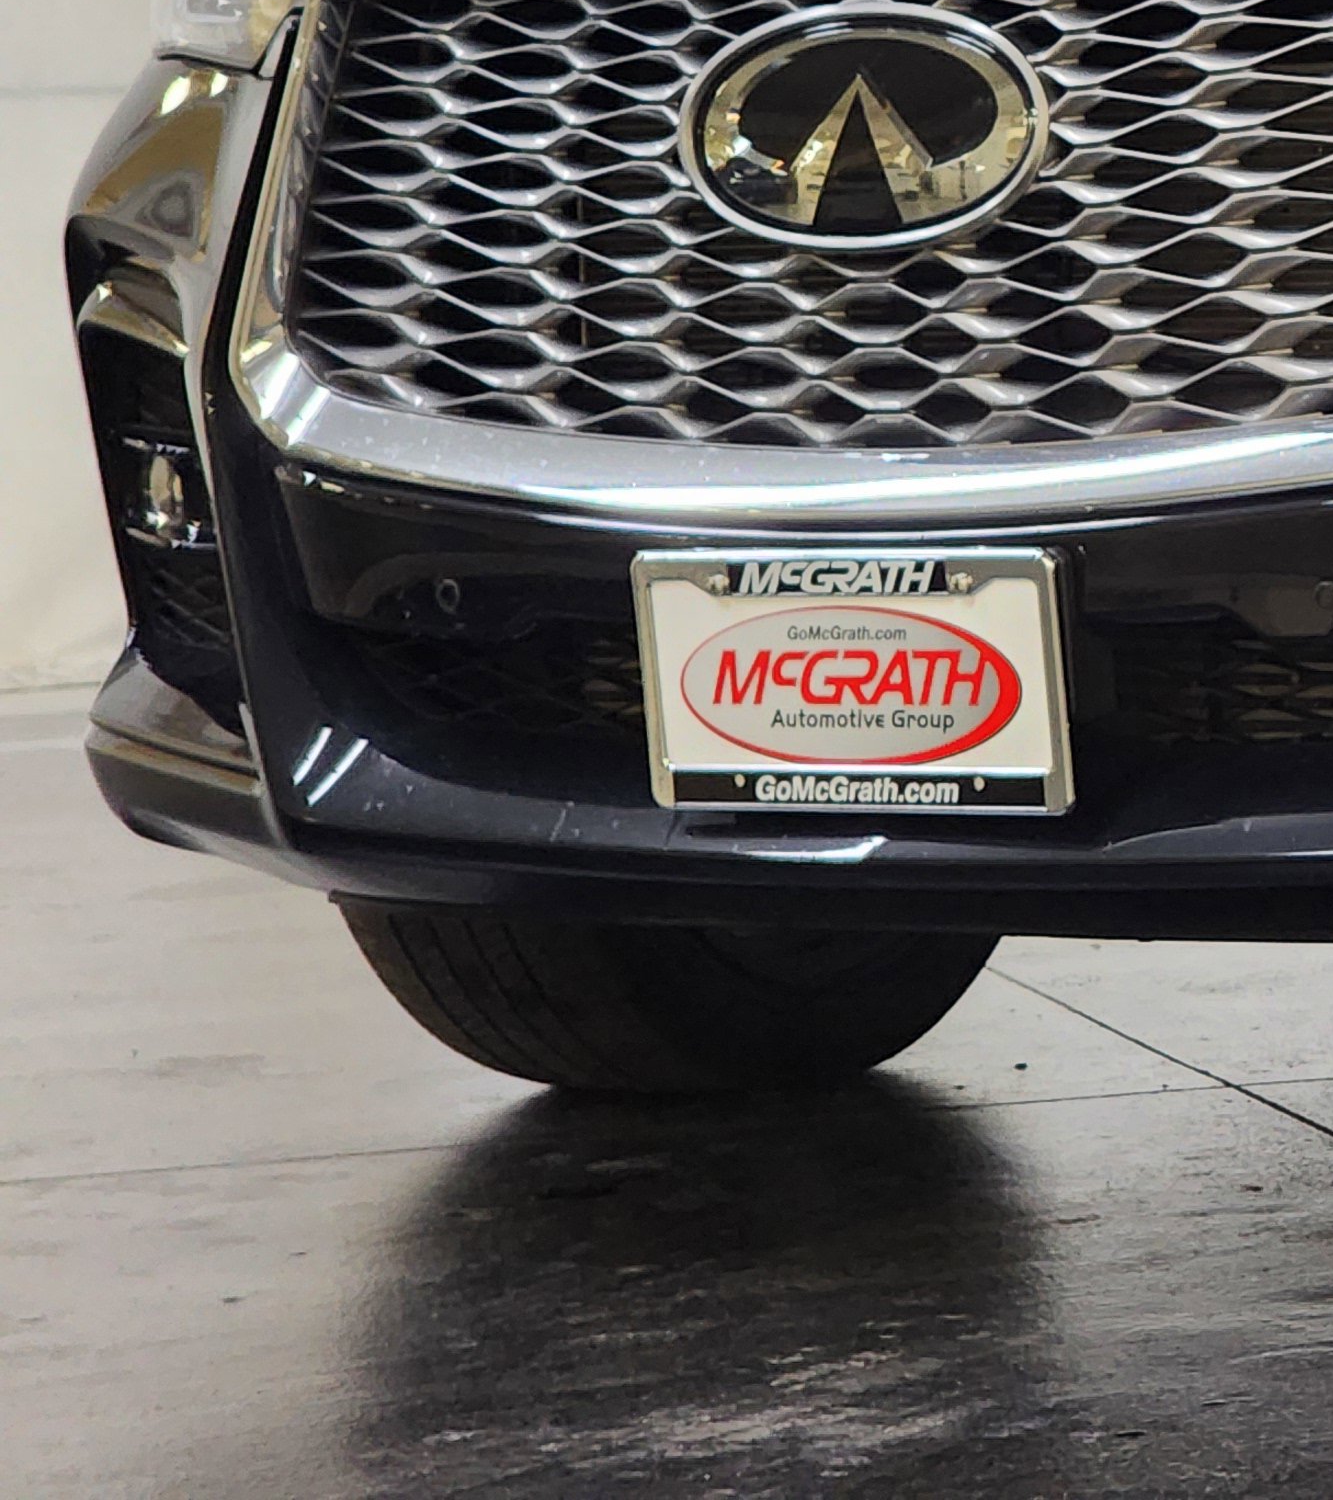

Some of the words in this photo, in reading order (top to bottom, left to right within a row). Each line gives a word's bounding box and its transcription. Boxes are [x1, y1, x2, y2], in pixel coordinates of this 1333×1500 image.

[787, 625, 907, 641] GoMcGrath.com
[770, 708, 885, 729] Automotive
[891, 709, 955, 733] Group
[754, 774, 961, 805] GoMcGrath.com
